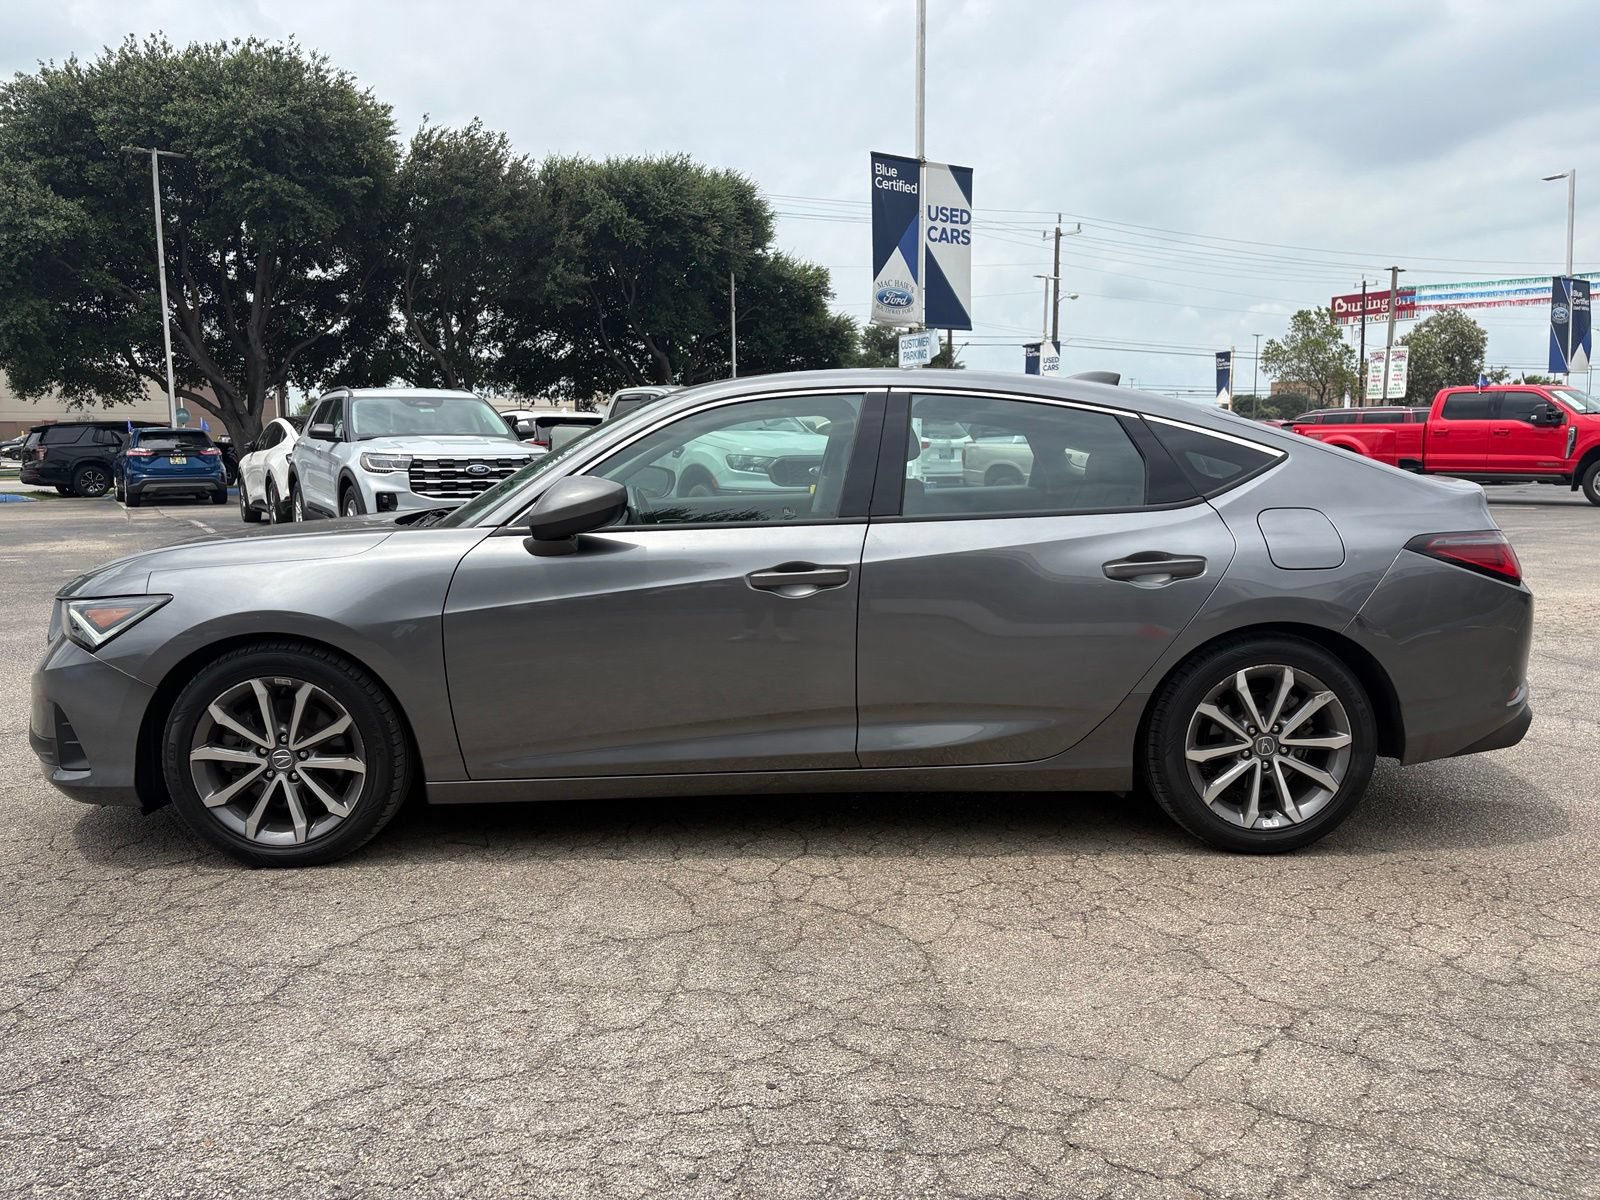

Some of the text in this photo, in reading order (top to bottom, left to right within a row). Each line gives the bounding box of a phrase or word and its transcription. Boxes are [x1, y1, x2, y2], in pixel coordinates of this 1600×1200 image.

[875, 162, 898, 177] Blue
[875, 177, 918, 194] Certified
[927, 205, 971, 225] USED
[927, 226, 971, 246] CARS
[877, 279, 893, 289] MAC
[883, 291, 908, 305] Ford
[1335, 294, 1412, 313] Burlingon
[1353, 315, 1373, 323] Paty
[900, 336, 930, 350] CUSTOMER
[902, 347, 927, 361] PARKING
